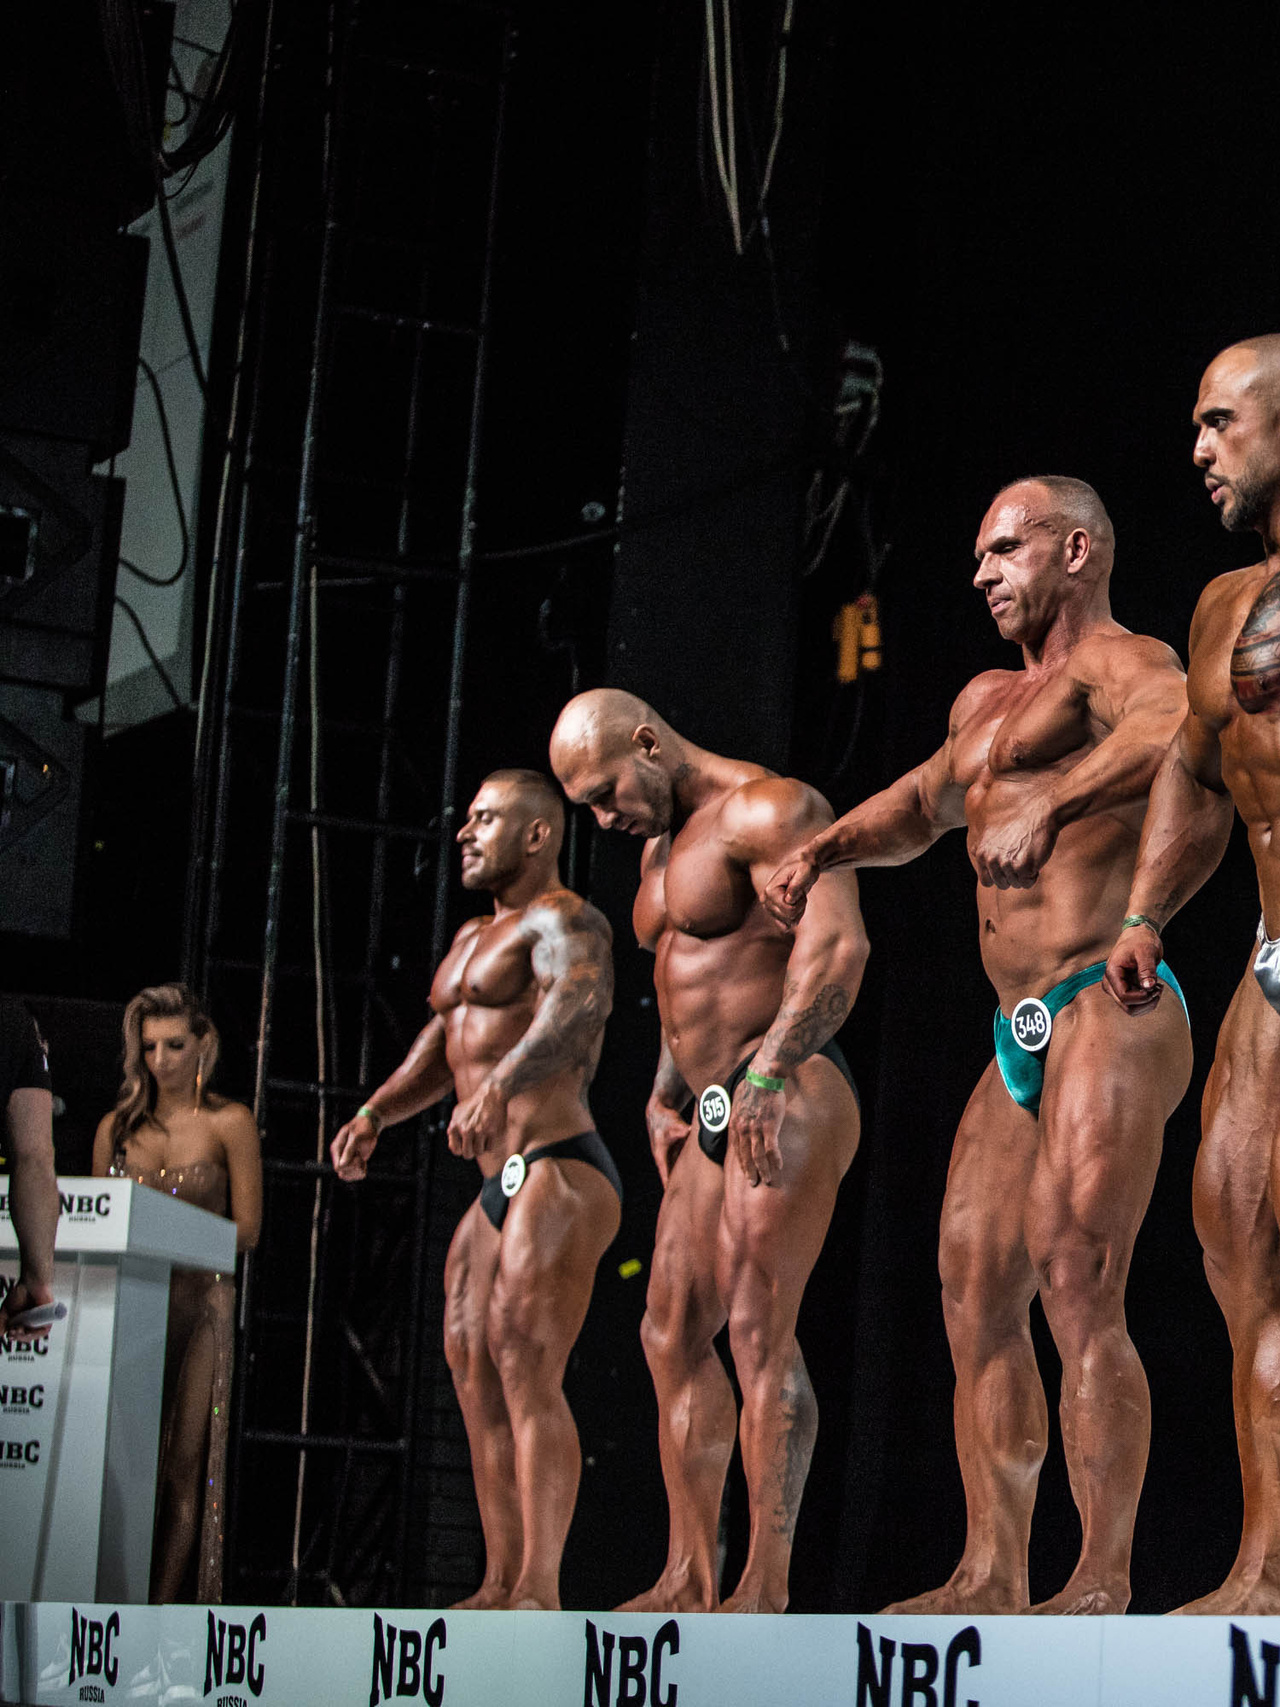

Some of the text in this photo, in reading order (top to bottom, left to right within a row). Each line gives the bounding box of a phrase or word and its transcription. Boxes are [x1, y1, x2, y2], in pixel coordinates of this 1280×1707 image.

[1016, 1011, 1046, 1039] 348
[704, 1096, 725, 1121] 315
[59, 1192, 110, 1216] NBC
[0, 1440, 40, 1464] BC
[69, 1606, 120, 1687] NBC
[203, 1608, 266, 1697] NBC
[369, 1612, 446, 1707] NBC
[584, 1618, 680, 1707] NBC
[856, 1621, 982, 1707] NBC
[79, 1685, 105, 1703] RUSSIA
